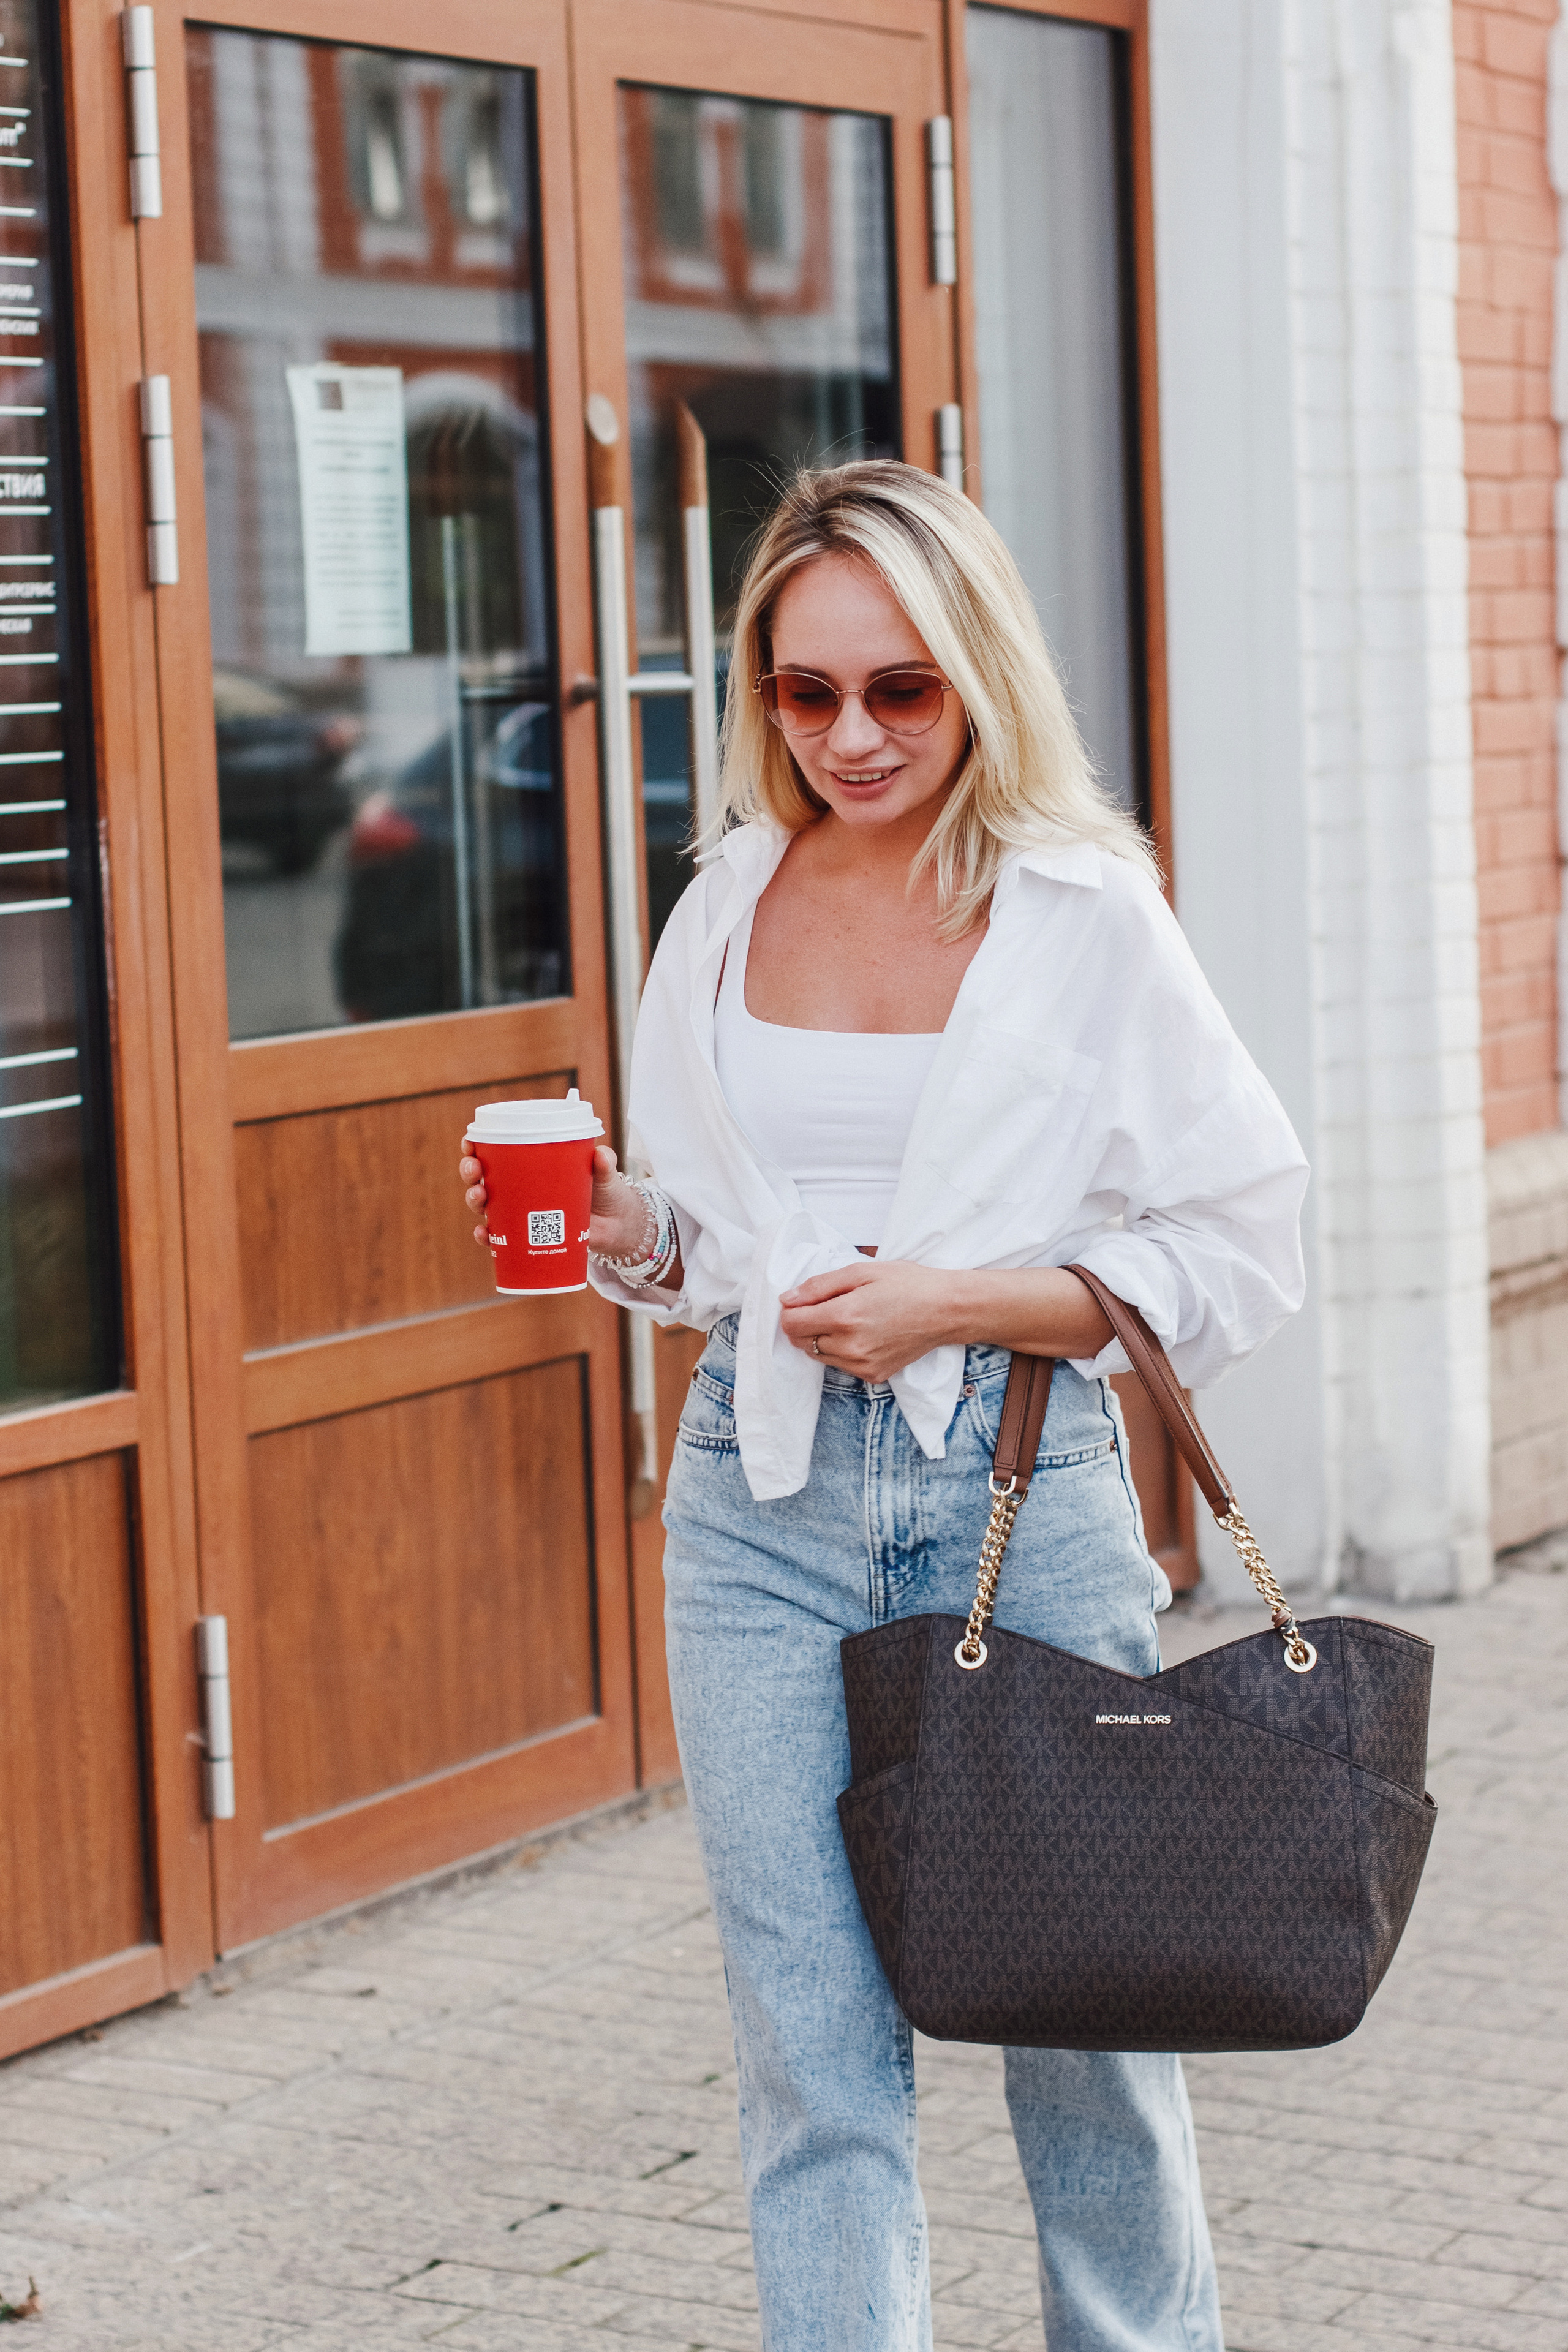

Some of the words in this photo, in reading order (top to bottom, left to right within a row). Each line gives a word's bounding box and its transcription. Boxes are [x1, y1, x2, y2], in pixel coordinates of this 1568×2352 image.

[489, 1233, 508, 1246] einl
[578, 1227, 590, 1242] Jul
[1095, 1714, 1142, 1724] MICHAEL
[1143, 1714, 1172, 1724] KORS
